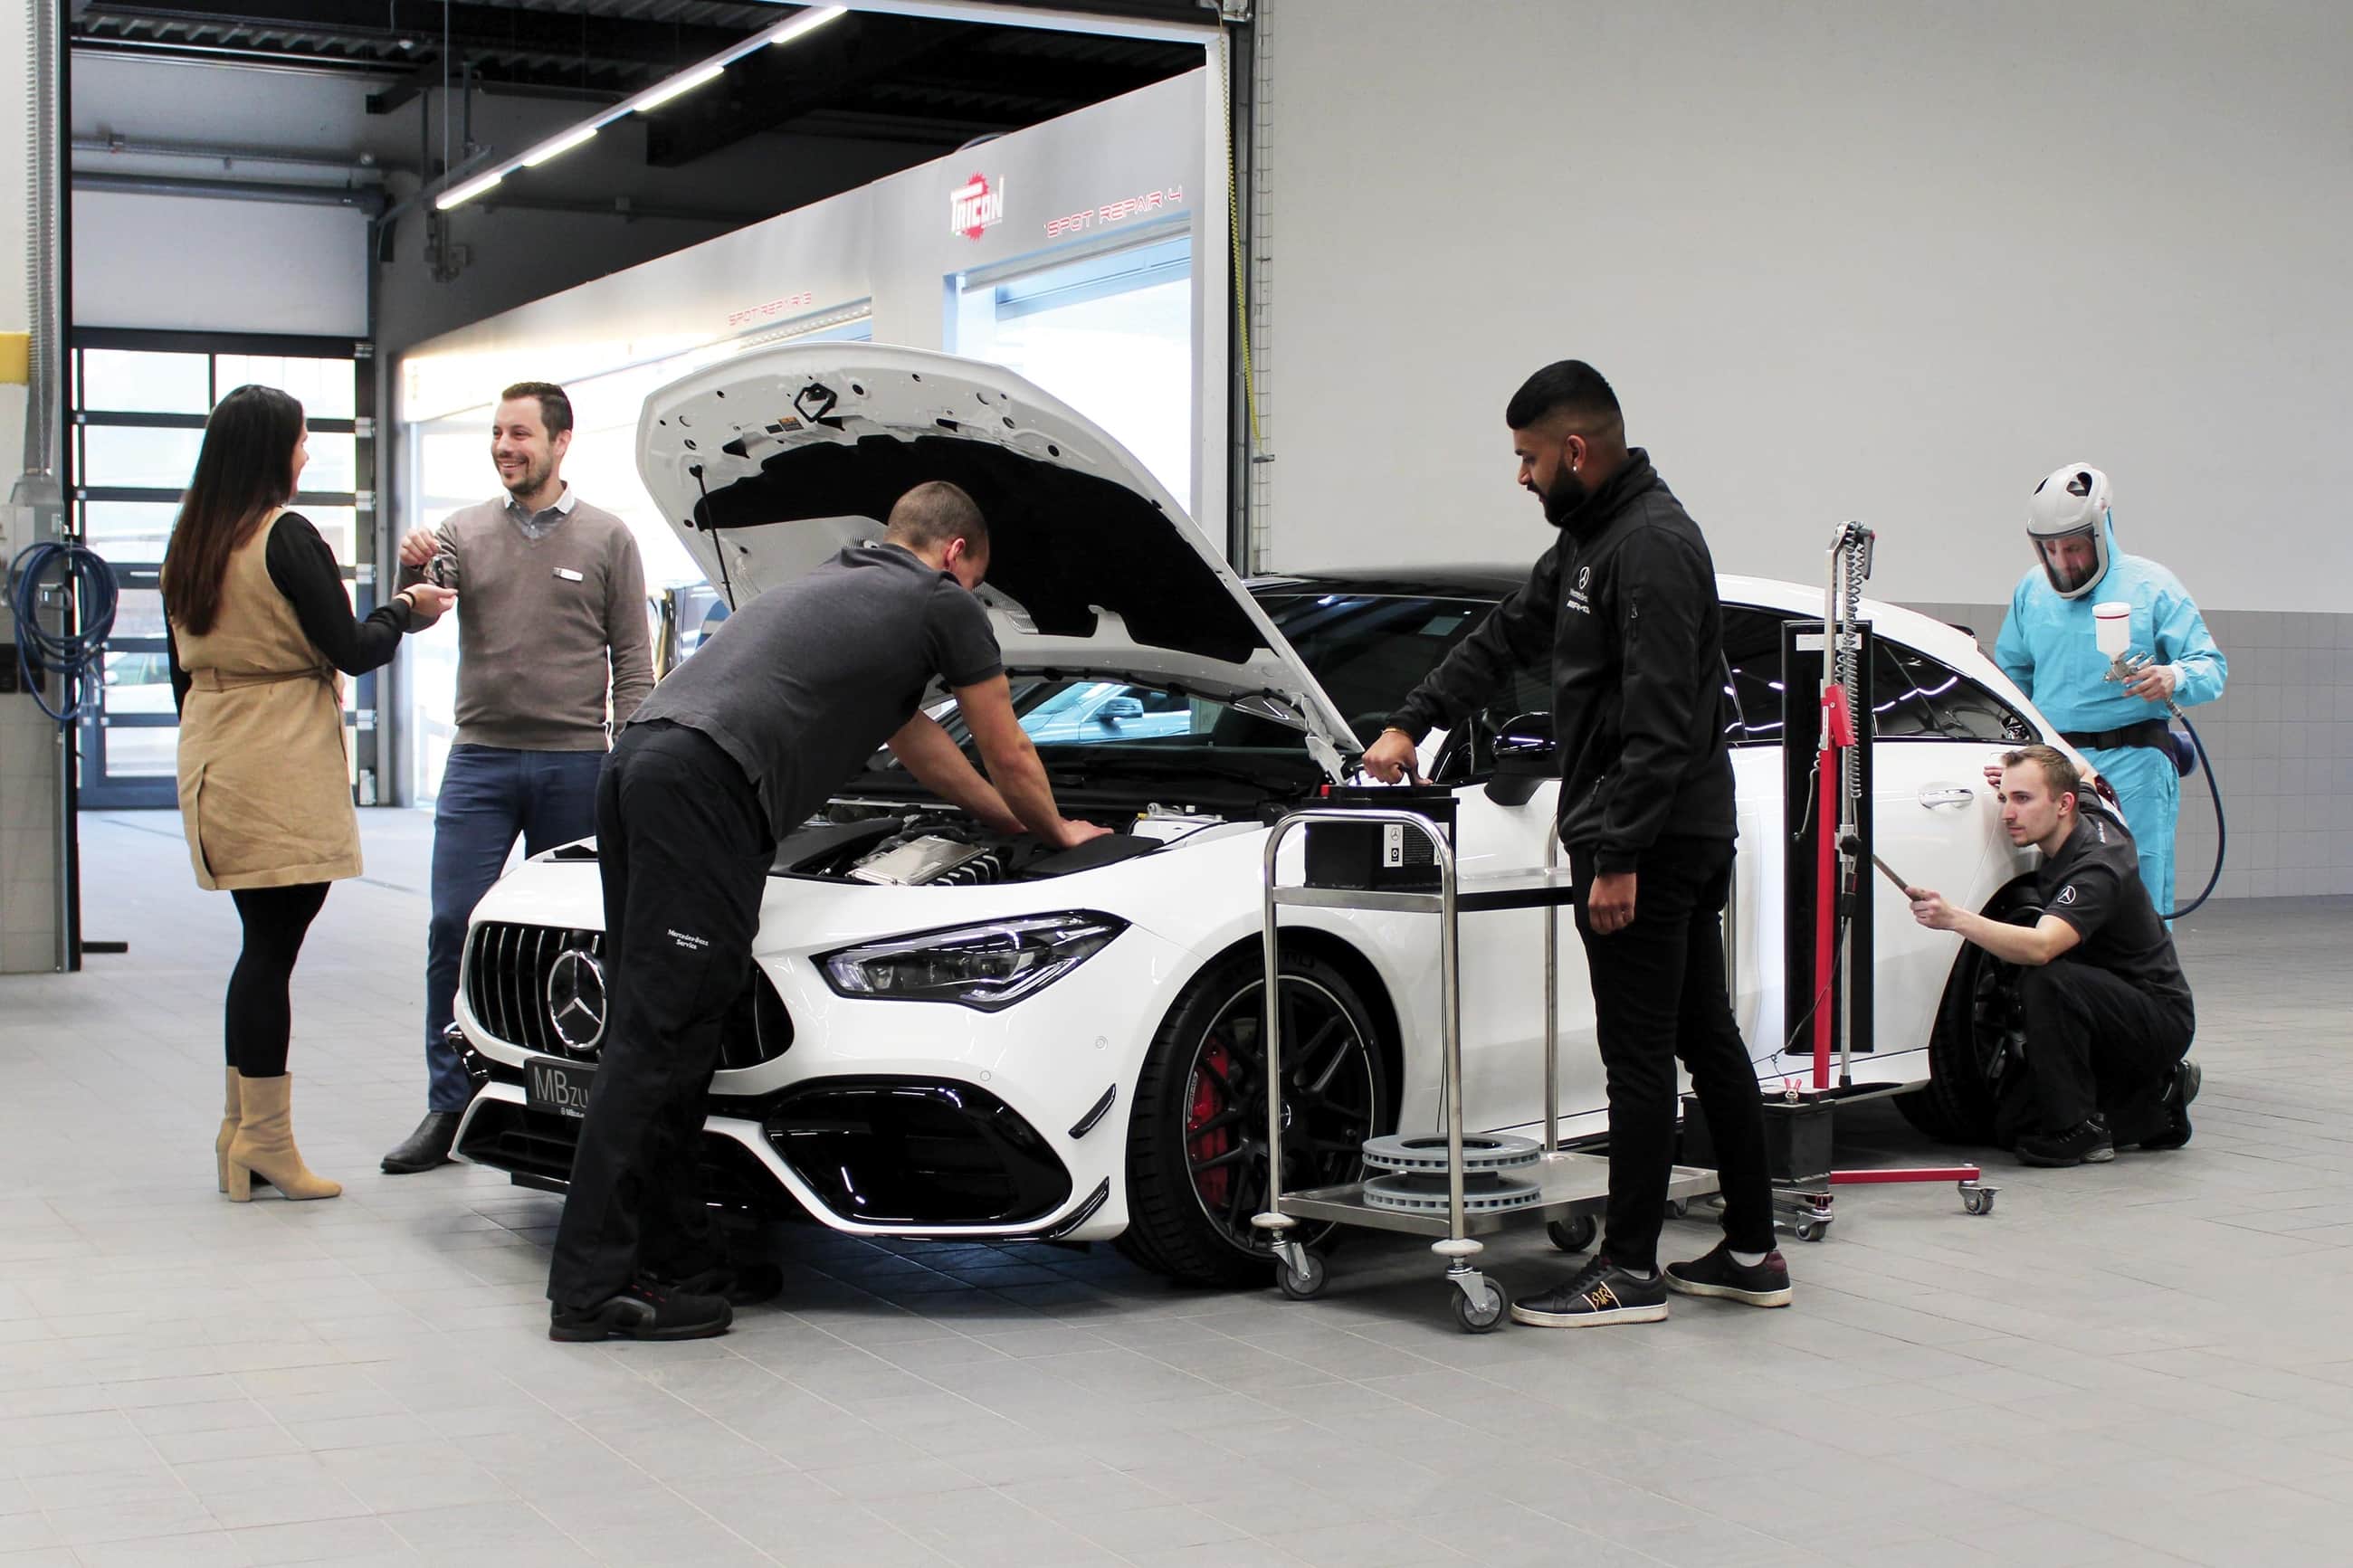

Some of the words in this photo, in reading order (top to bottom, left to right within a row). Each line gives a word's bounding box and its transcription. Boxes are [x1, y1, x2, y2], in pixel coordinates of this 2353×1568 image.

[1046, 210, 1094, 239] SPOT
[1099, 191, 1164, 224] REPAIR
[1167, 185, 1182, 209] 4
[729, 308, 758, 327] SPOT
[760, 296, 799, 317] REPAIR
[803, 291, 812, 305] 3
